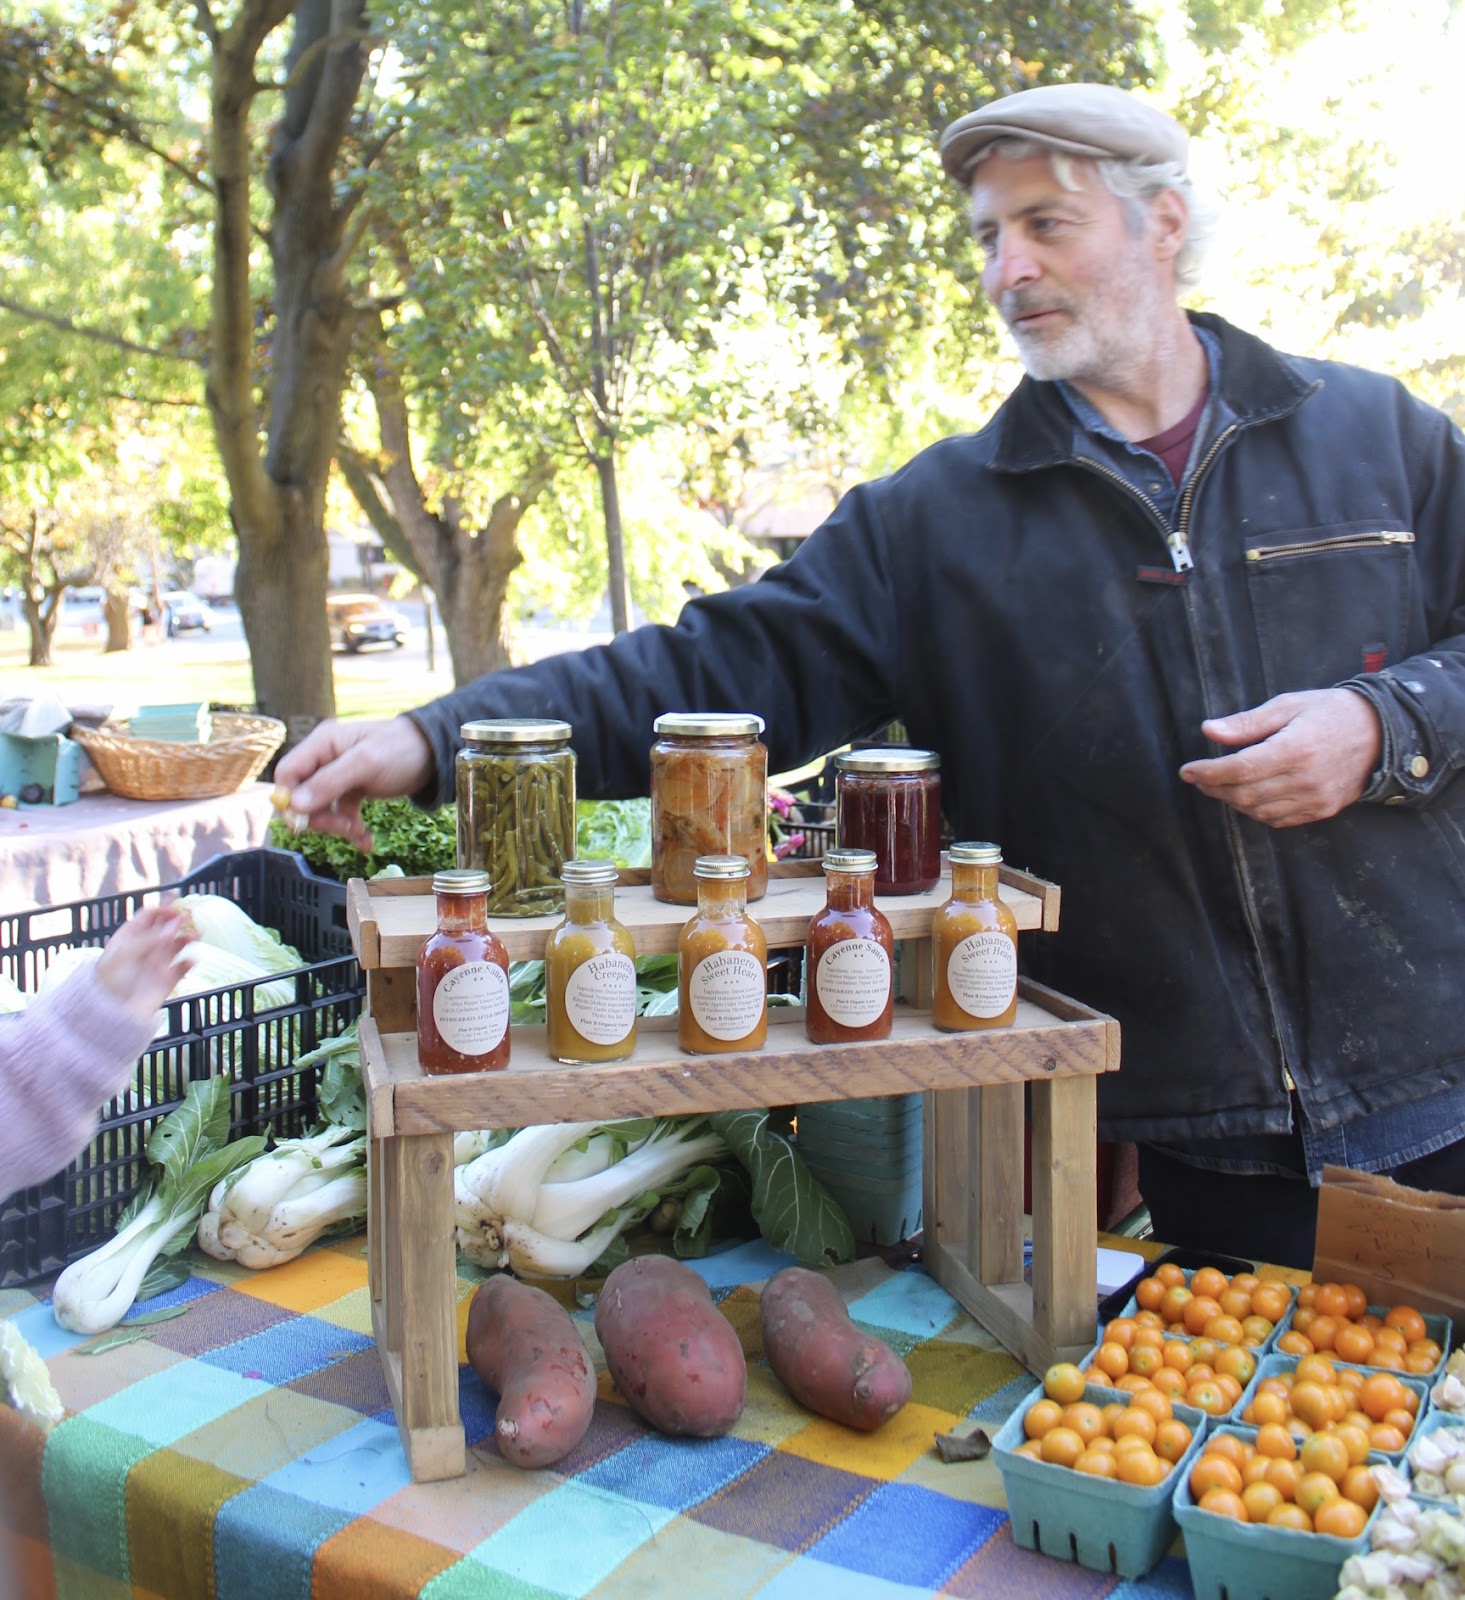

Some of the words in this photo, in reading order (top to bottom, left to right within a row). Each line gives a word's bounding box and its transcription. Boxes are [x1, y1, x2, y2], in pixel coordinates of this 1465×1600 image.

[965, 936, 1012, 951] Habanero
[826, 944, 863, 965] Cayenne
[866, 943, 885, 964] Sauce
[961, 947, 989, 963] Sweet
[993, 946, 1012, 963] Heart
[588, 958, 633, 975] Habanero
[703, 956, 755, 972] Habanero
[443, 966, 482, 992] Cayenne
[485, 964, 504, 984] Sauce
[594, 971, 629, 981] Creeper
[701, 968, 729, 985] Sweet
[733, 966, 757, 981] Heart
